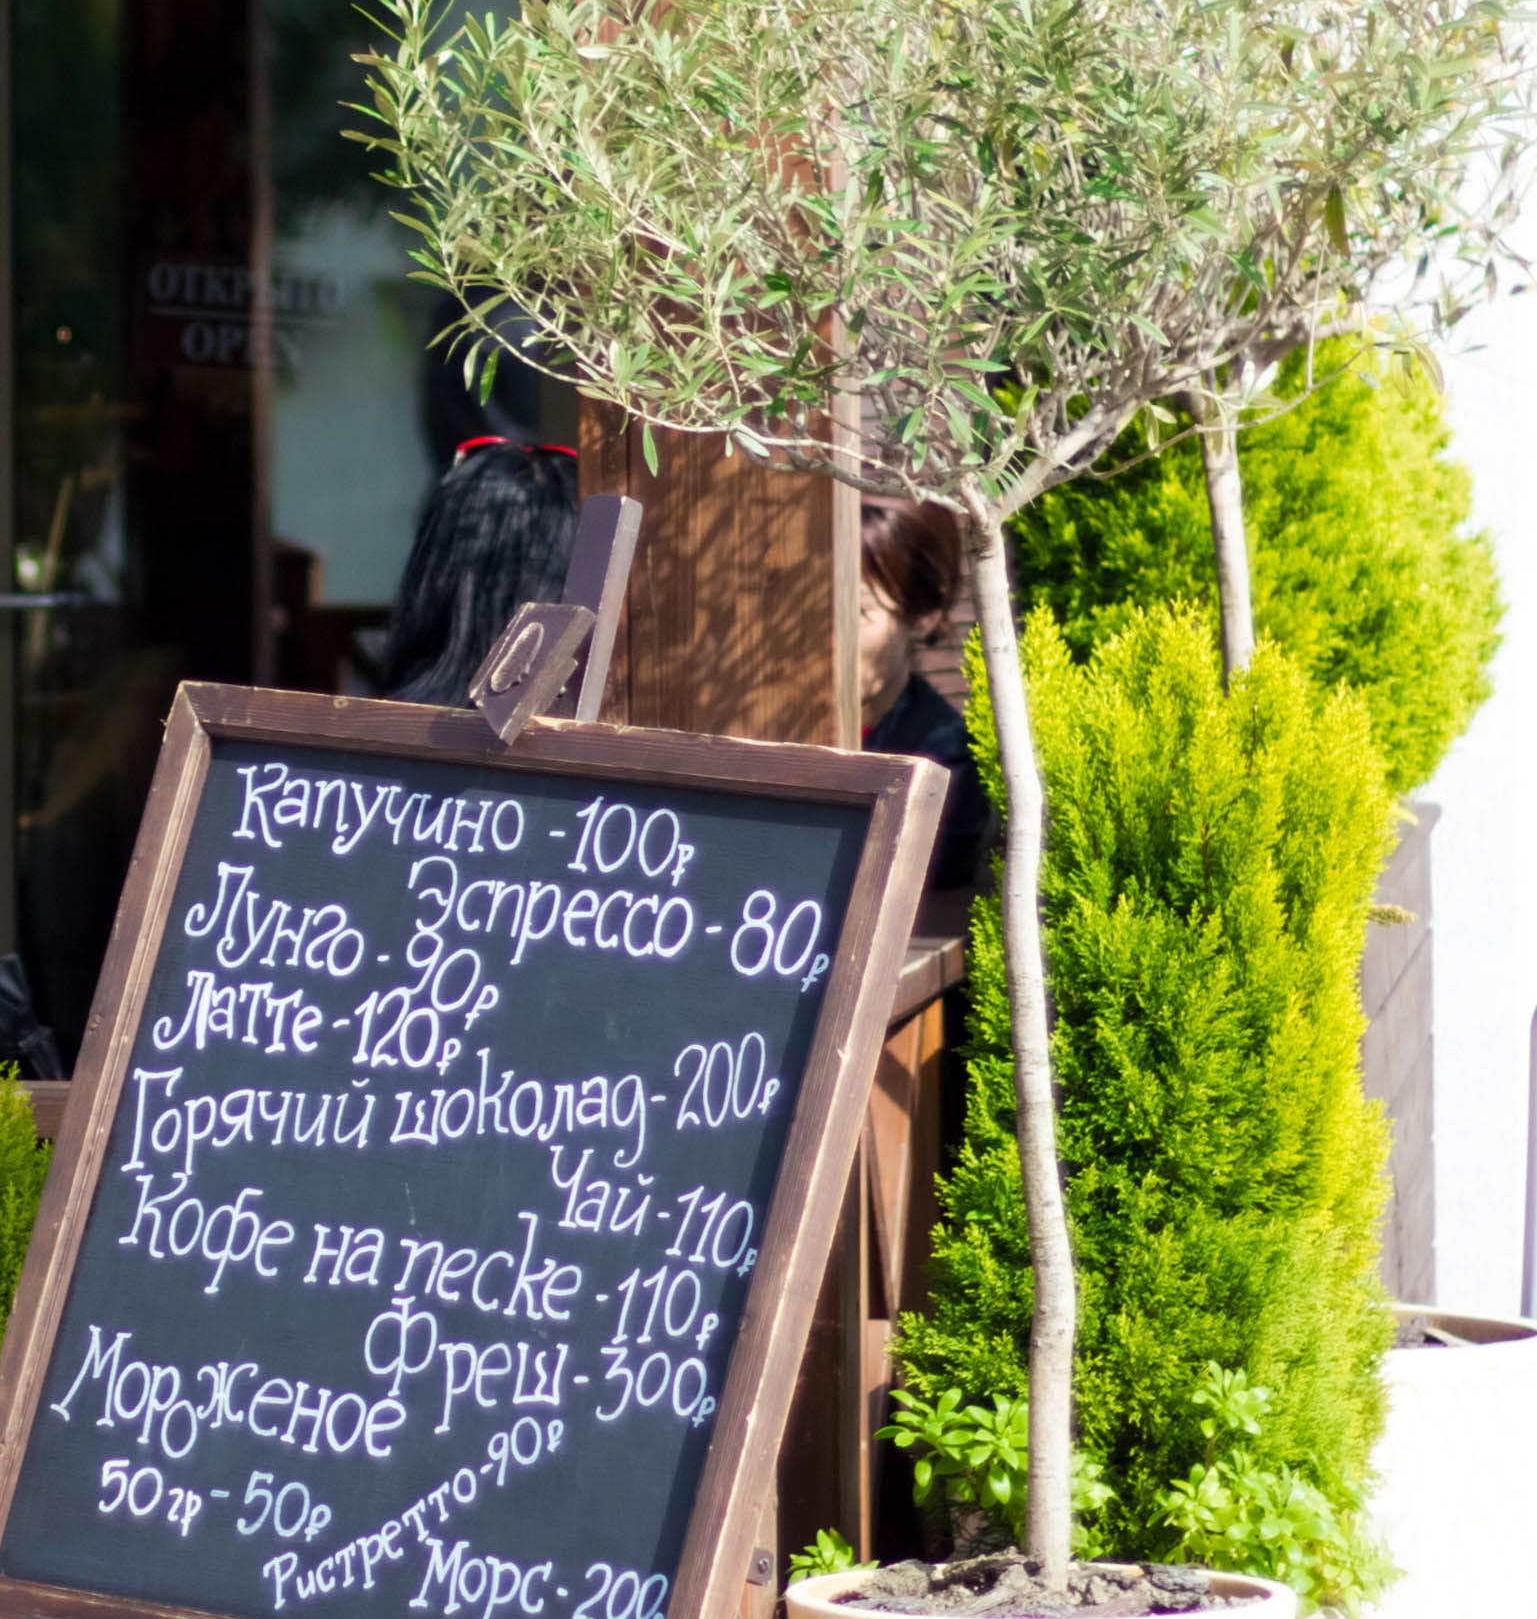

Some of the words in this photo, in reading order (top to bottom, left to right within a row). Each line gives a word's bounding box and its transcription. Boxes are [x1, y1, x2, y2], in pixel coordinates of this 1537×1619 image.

[232, 763, 525, 855] Капучино
[184, 862, 365, 976] Лунго
[408, 856, 694, 965] Эспрессо
[152, 970, 323, 1054] Латте
[120, 1067, 377, 1176] Горячий
[389, 1047, 647, 1168] шоколад
[118, 1172, 295, 1295] Кофе
[303, 1223, 385, 1286] на
[393, 1211, 582, 1320] песке
[549, 1145, 655, 1236] Чай
[50, 1324, 407, 1458] Мороженое
[364, 1296, 568, 1434] Фреш
[262, 1468, 477, 1610] Ристретто
